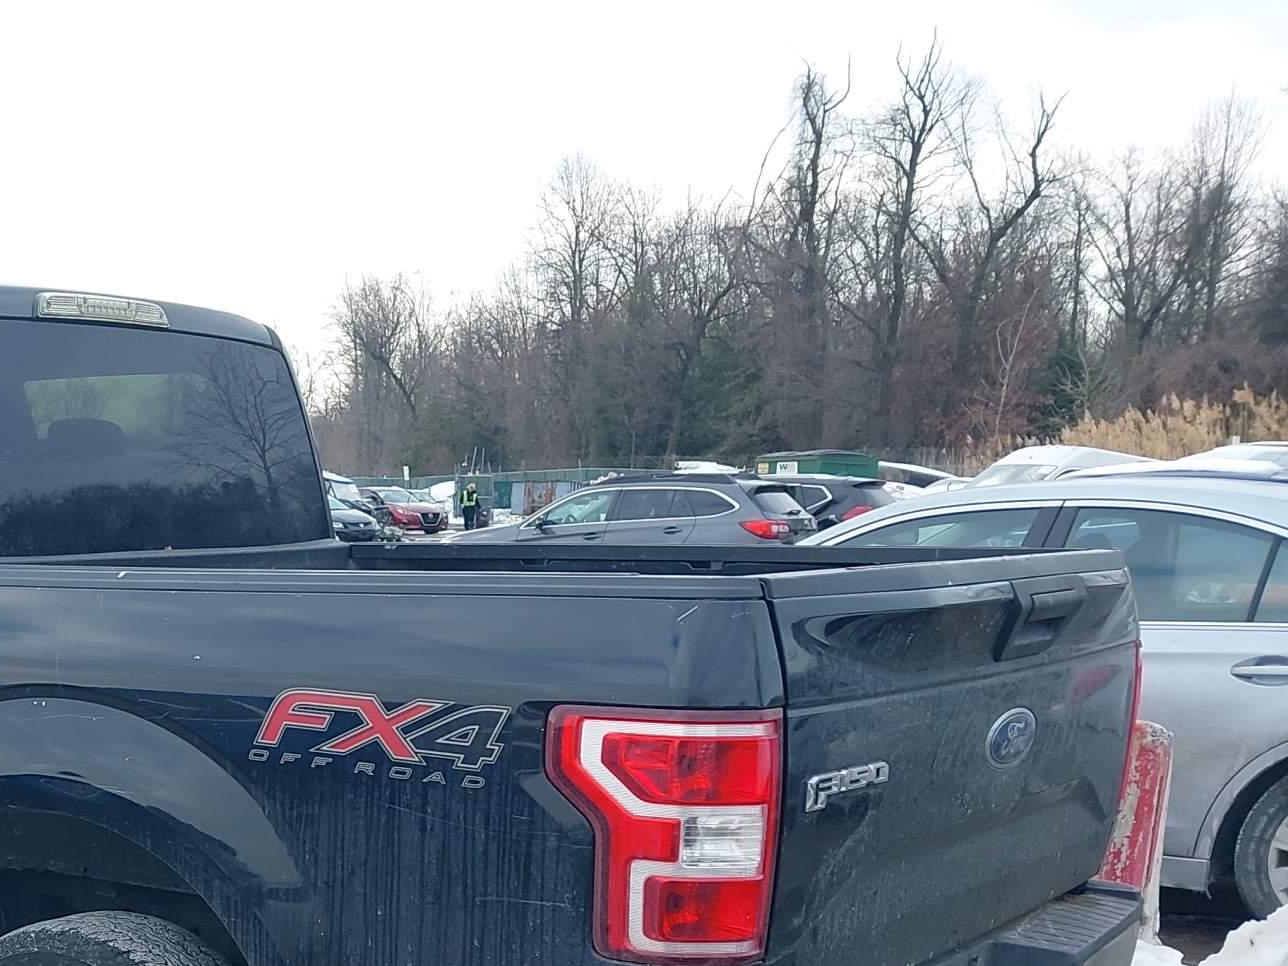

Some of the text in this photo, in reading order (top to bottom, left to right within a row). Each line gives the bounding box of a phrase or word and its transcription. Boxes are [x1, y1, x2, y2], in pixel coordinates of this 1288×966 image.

[253, 687, 512, 772] FX4
[248, 749, 486, 789] OFF ROAD
